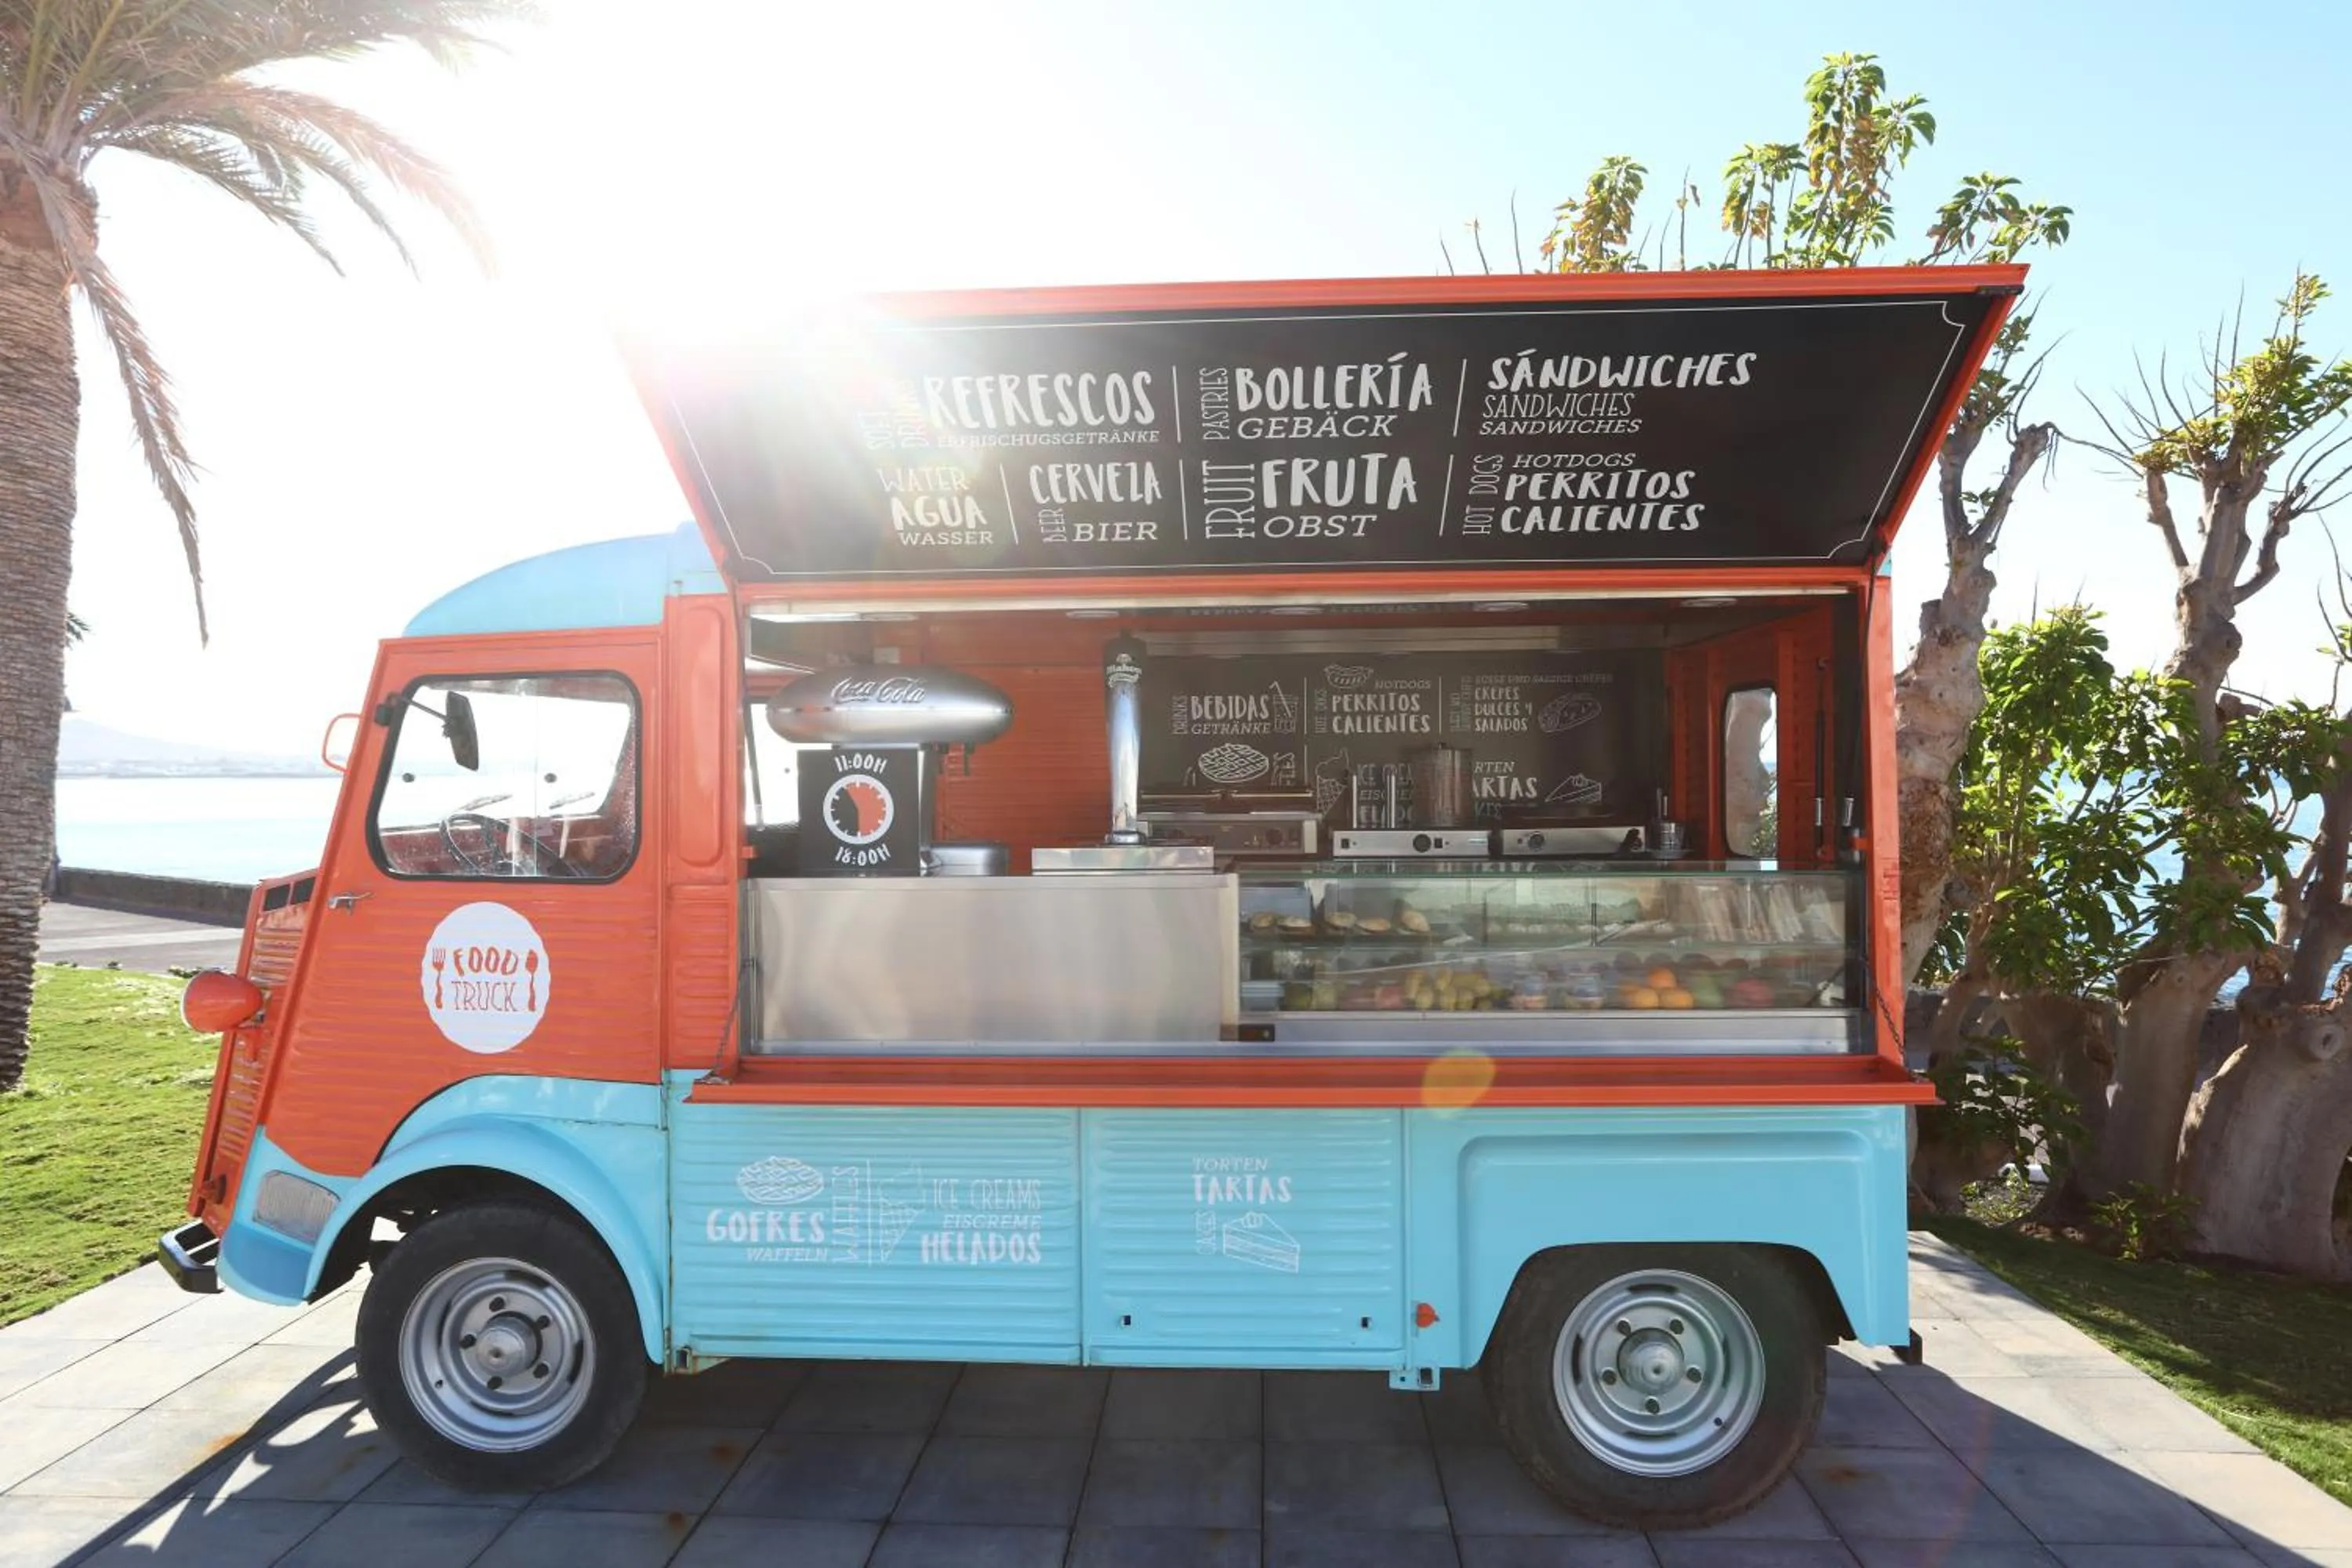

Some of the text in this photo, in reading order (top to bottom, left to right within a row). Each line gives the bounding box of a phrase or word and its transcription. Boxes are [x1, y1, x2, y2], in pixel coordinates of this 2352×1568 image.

[1235, 351, 1433, 412] BOLLERÍA
[1488, 348, 1758, 392] SÁNDWICHES
[923, 371, 1155, 429] REFRESCOS
[1200, 367, 1230, 440] PASTRIES
[1482, 393, 1635, 419] SANDWICHES
[1237, 411, 1399, 440] GEBÄCK
[1479, 419, 1642, 435] SANDWICHES
[1512, 452, 1636, 469] HOTDOGS
[876, 466, 971, 493] WATER
[1029, 461, 1163, 505] CERVEZA
[1261, 452, 1418, 510] FRUTA
[1504, 469, 1697, 501] PERRITOS
[1202, 460, 1255, 539] FRUIT
[1462, 454, 1504, 535] HOT DOGS
[891, 495, 989, 531] AGUA
[1037, 508, 1068, 543] BEER
[1263, 514, 1377, 538] OBST
[1500, 503, 1706, 535] CALIENTES
[898, 531, 995, 546] WASSER
[1072, 521, 1159, 543] BIER
[1191, 695, 1270, 721] BEBIDAS
[1332, 692, 1421, 713] PERRITOS
[1475, 702, 1519, 716] DULCES
[1191, 720, 1271, 735] GETRÄNKE
[1332, 713, 1432, 735] CALIENTES
[1474, 717, 1528, 733] SALADOS
[834, 753, 887, 773] 11:00H
[1474, 760, 1515, 774] RTEN
[1472, 775, 1537, 800] RTAS
[453, 946, 519, 977] FOOD
[451, 981, 519, 1011] TRUCK
[1192, 1157, 1269, 1172] TORTEN
[934, 1178, 1041, 1210] ICE CREAMS
[1192, 1174, 1292, 1205] TARTAS
[707, 1208, 825, 1243] GOFRES
[943, 1214, 1042, 1229] EISCREME
[746, 1247, 828, 1261] WAFFELN
[921, 1232, 1042, 1265] HELADOS
